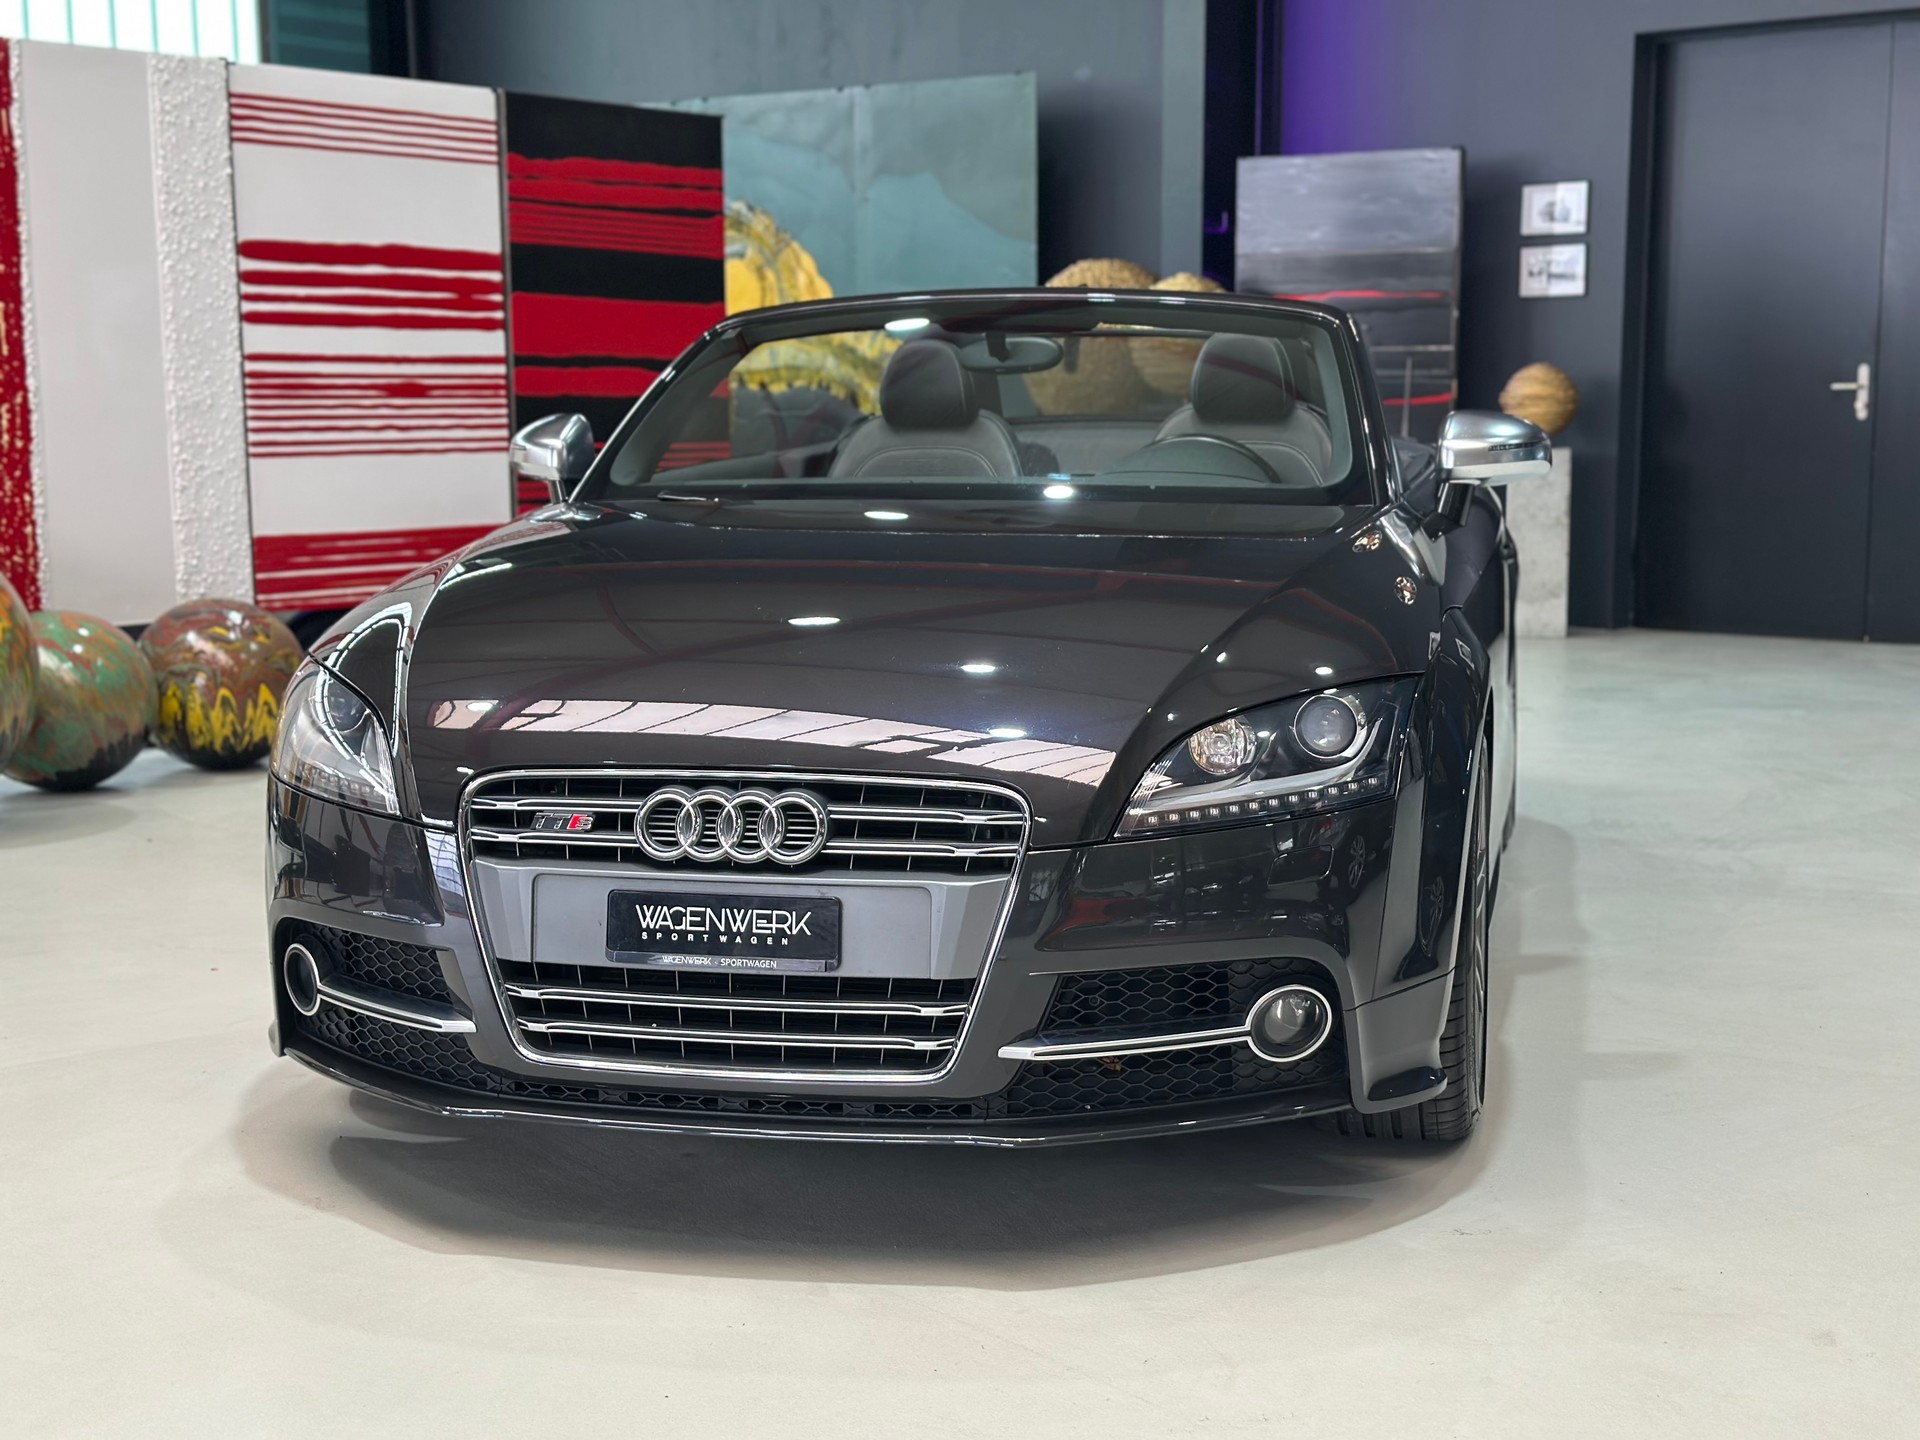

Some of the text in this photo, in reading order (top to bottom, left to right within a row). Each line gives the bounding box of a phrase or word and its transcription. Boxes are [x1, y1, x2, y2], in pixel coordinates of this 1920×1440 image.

[534, 812, 594, 831] TTS
[635, 904, 812, 936] WAGENWERK
[641, 932, 789, 946] SPORTWAGEN
[662, 955, 712, 965] WAGENWERK
[720, 957, 777, 968] SPORTWAGEN
